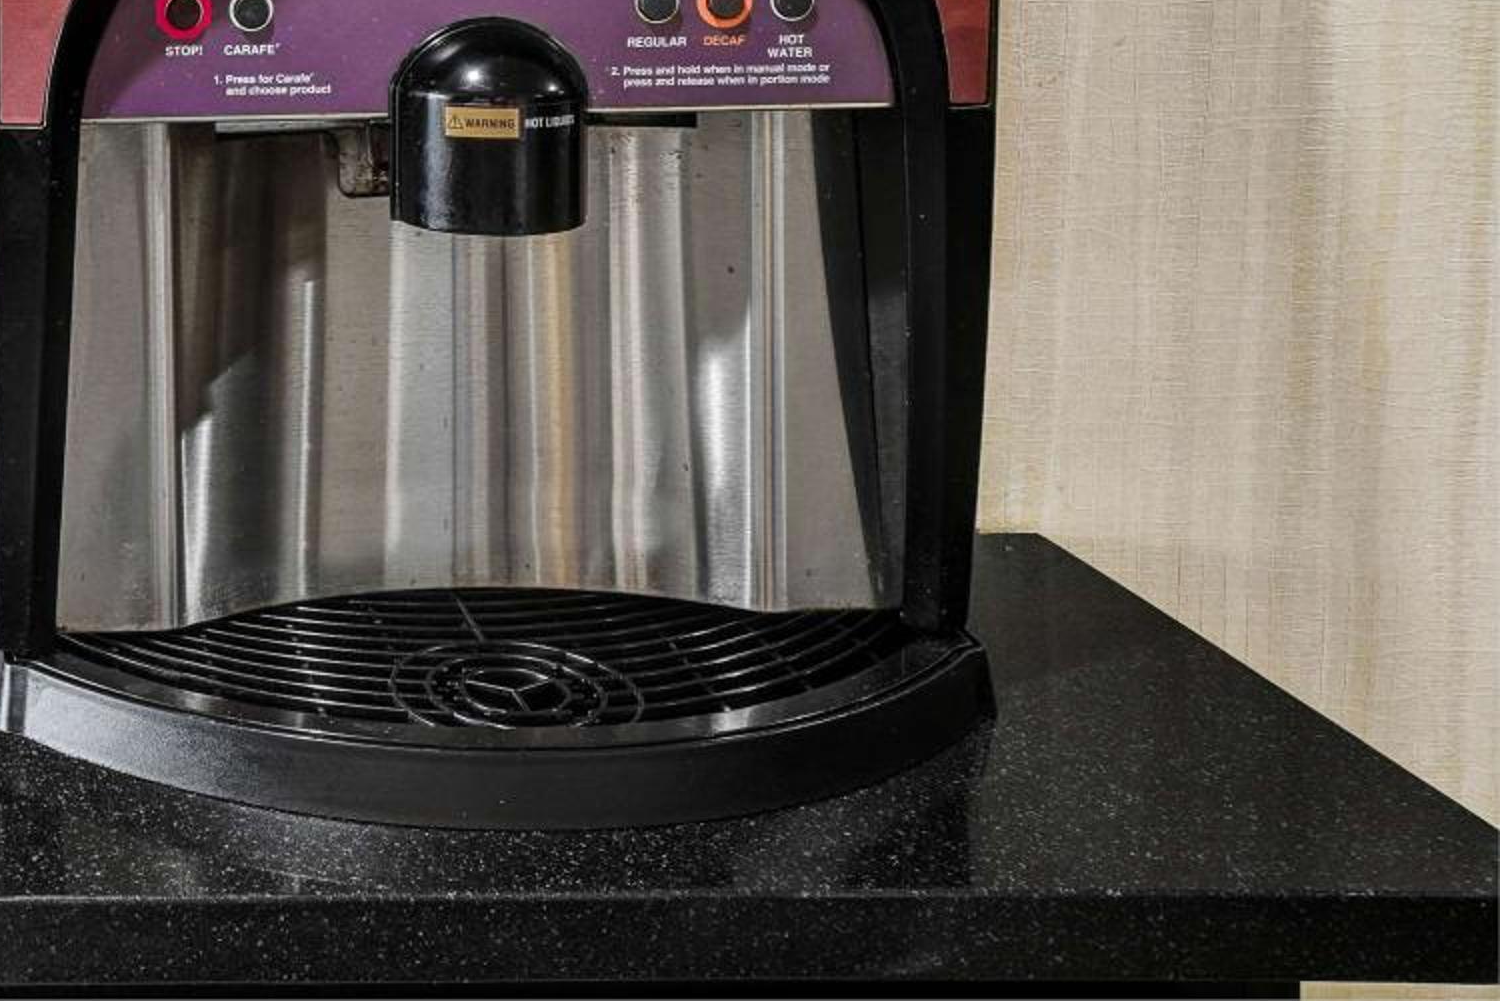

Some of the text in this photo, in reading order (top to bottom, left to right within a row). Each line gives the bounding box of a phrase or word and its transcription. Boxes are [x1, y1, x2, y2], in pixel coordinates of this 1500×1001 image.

[627, 36, 687, 48] REGULAR
[704, 35, 746, 46] DECAF
[779, 34, 804, 45] HOT
[165, 45, 203, 56] STOP!
[768, 47, 813, 58] WATER
[623, 65, 653, 76] Press
[655, 65, 675, 76] and
[677, 64, 701, 74] hold
[703, 64, 732, 74] when
[733, 63, 744, 74] in
[746, 63, 784, 73] manual
[787, 62, 816, 72] mode
[818, 64, 831, 72] or
[213, 74, 223, 85] 1.
[225, 74, 256, 84] Press
[258, 73, 273, 83] for
[623, 73, 831, 91] press and release when in portion mode
[225, 83, 331, 97] and choose product
[465, 118, 516, 130] WARNING
